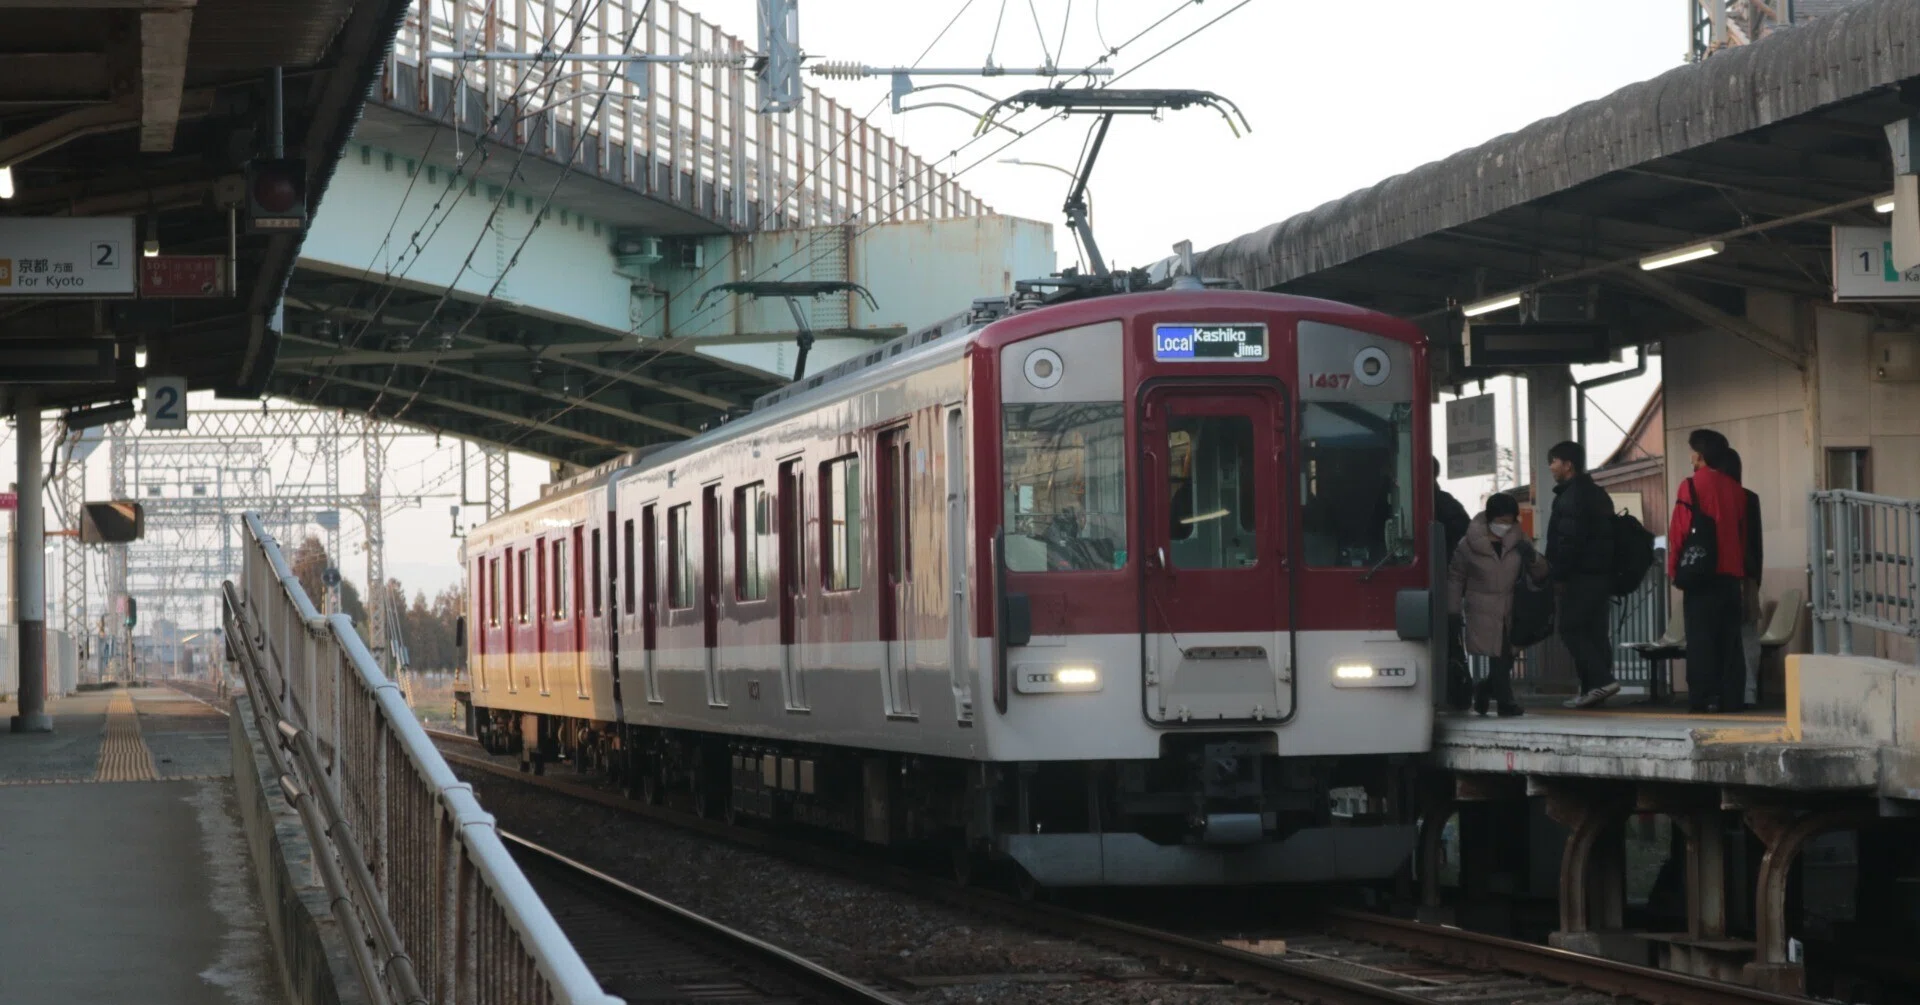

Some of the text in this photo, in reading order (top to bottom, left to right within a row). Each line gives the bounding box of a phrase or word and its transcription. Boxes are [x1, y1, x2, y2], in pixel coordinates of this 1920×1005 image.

[97, 244, 113, 266] 2
[1860, 251, 1869, 272] 1
[18, 258, 73, 273] 京都 方面
[18, 276, 84, 289] For Kyoto
[1157, 334, 1193, 351] Local
[1194, 328, 1246, 342] Kashiko
[1234, 342, 1262, 358] jima
[1309, 373, 1350, 388] 1437
[155, 386, 178, 420] 2
